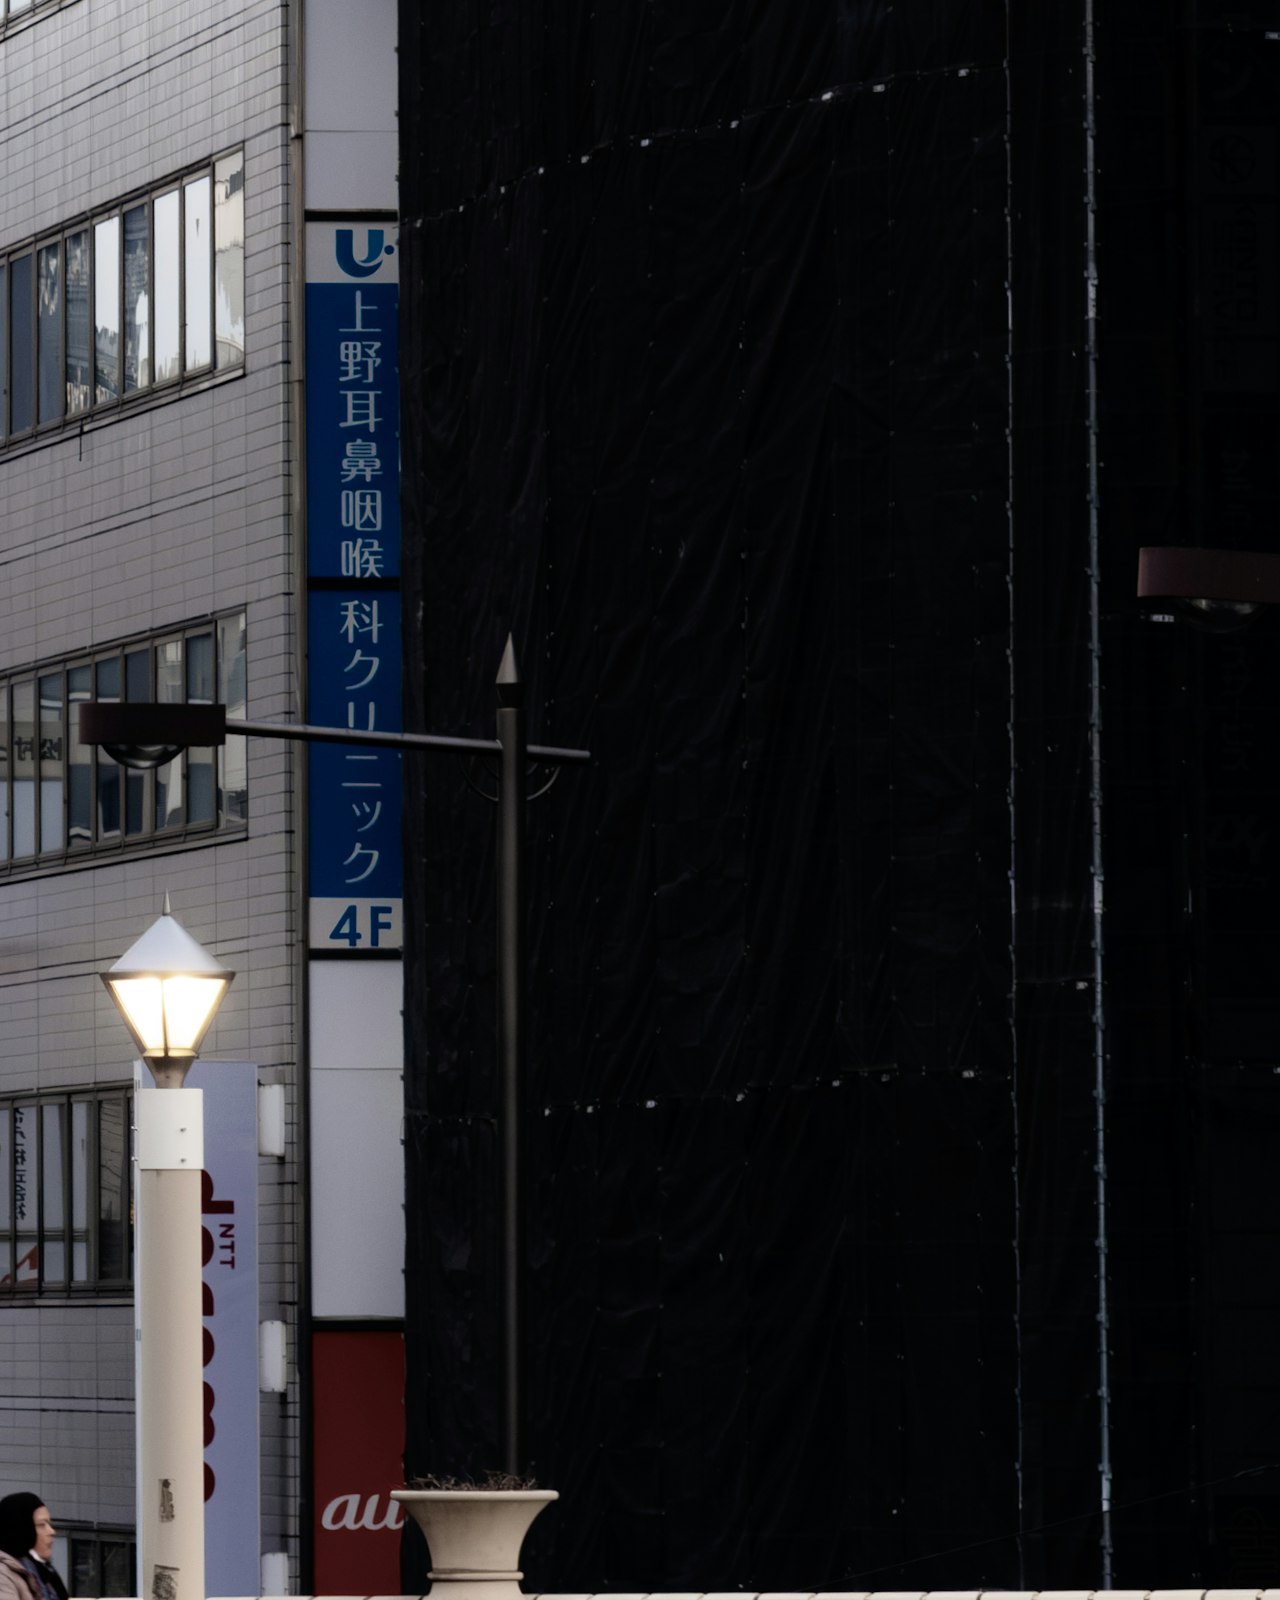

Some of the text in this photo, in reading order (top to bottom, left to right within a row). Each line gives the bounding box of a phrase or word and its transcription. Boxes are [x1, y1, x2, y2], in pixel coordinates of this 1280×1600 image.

[329, 904, 392, 947] 4F
[219, 1222, 235, 1269] NTT
[321, 1494, 404, 1531] au
